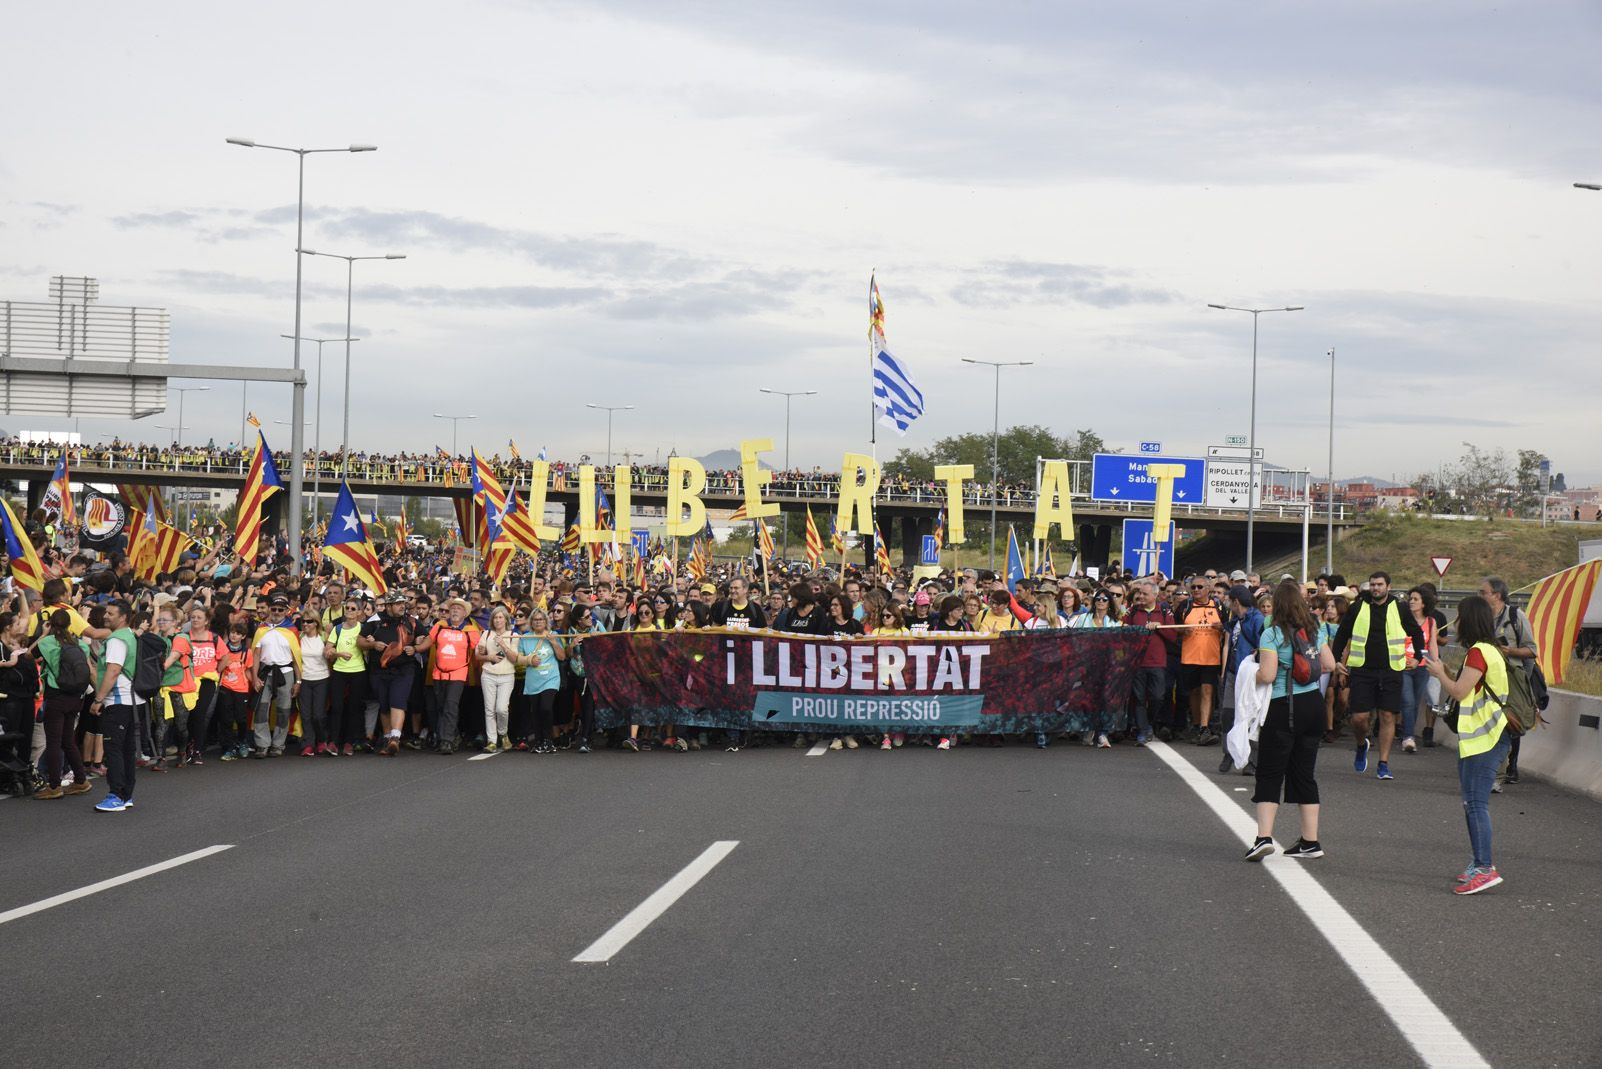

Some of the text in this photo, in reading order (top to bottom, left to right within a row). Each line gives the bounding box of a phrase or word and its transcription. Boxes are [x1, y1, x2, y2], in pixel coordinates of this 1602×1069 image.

[1209, 468, 1244, 476] RIPOLLET
[1210, 480, 1259, 488] CERDANYOA
[752, 640, 991, 691] LLIBERTAT
[792, 695, 941, 721] PROU REPRESSIÓ
